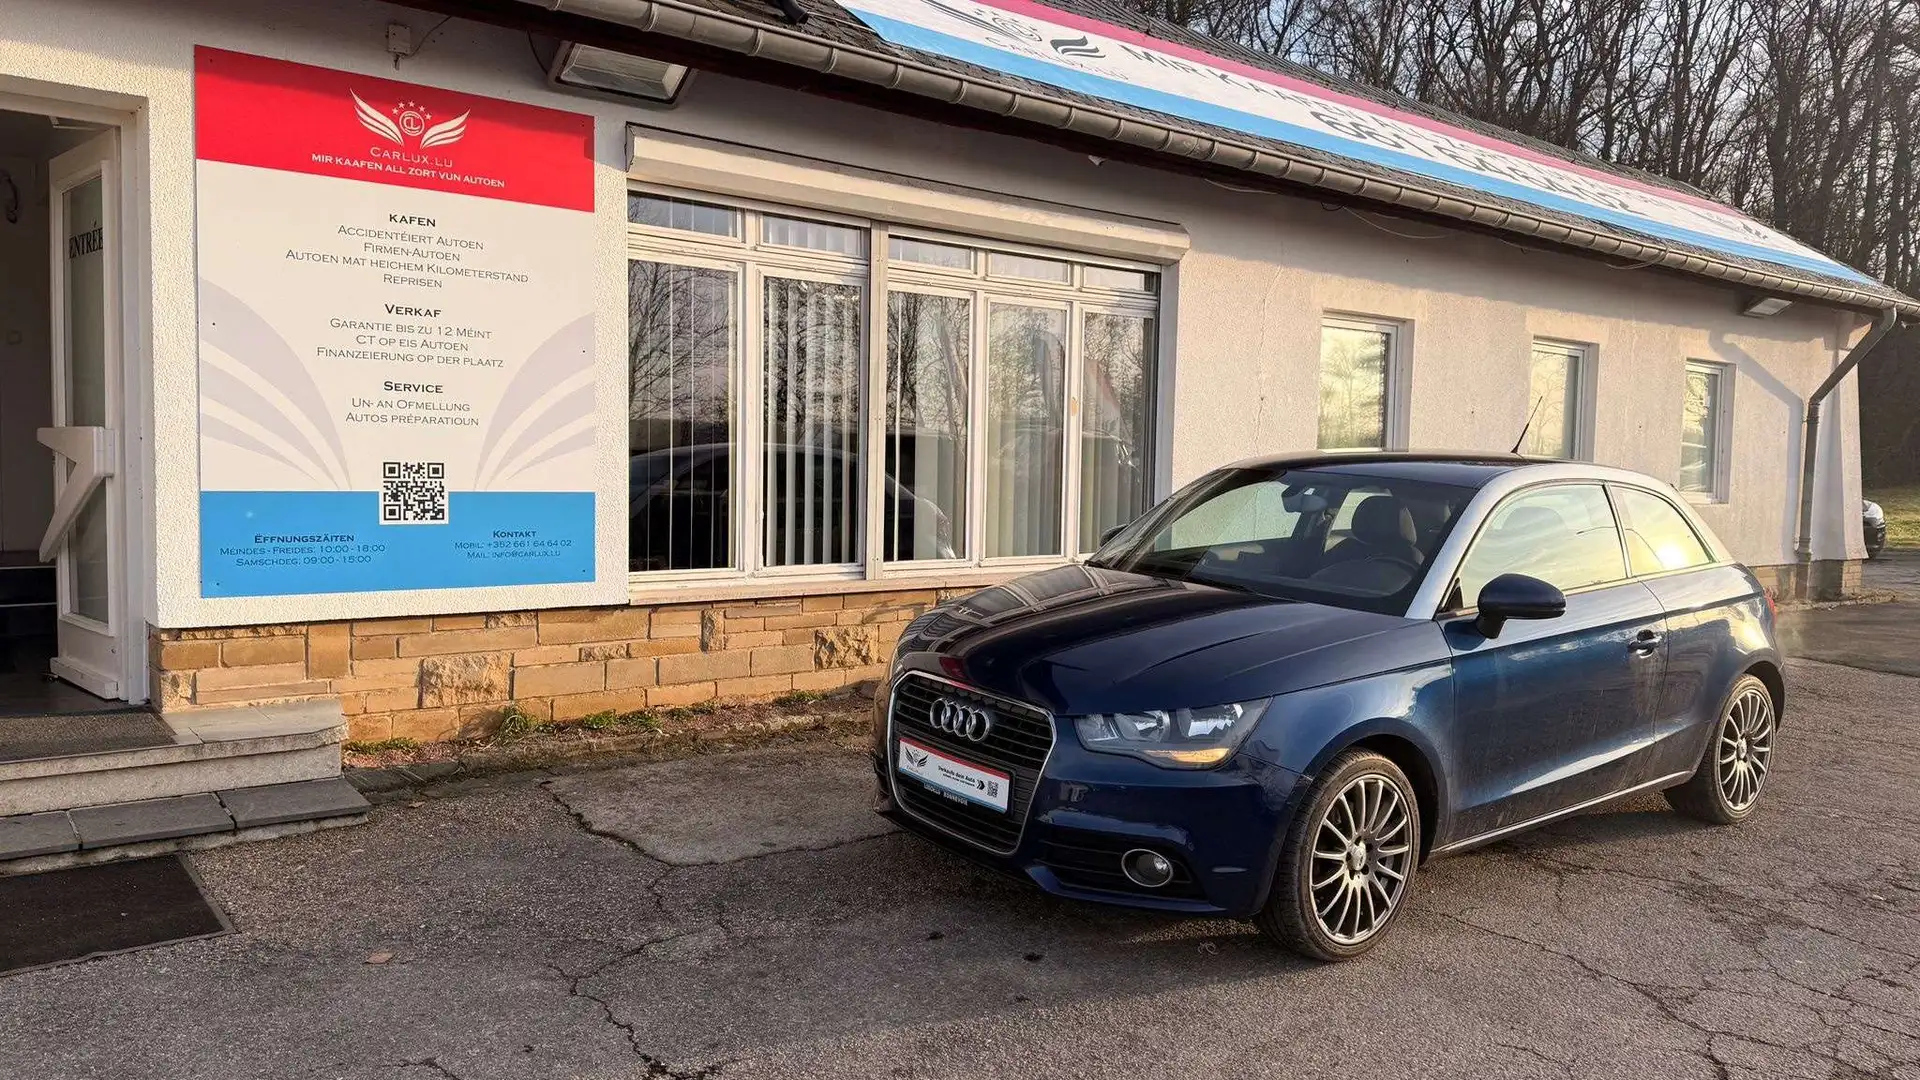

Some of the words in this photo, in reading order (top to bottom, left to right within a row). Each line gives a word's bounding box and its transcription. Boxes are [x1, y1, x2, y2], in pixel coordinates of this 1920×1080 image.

[1118, 44, 1207, 78] MIR
[1310, 111, 1435, 158] 661
[370, 146, 453, 168] CARLUX.LU
[311, 153, 333, 164] MIR
[335, 157, 383, 171] KAAFEN
[385, 164, 406, 175] ALL
[408, 167, 437, 178] ZORT
[438, 171, 461, 182] VUN
[463, 175, 505, 188] AUTOEN
[389, 213, 436, 227] KAFEN
[338, 224, 434, 244] ACCIDENTÉIERT
[436, 236, 484, 250] AUTOEN
[364, 242, 460, 261] FIRMEN-AUTOEN
[286, 249, 339, 264] AUTOEN
[342, 256, 367, 266] MAT
[370, 259, 424, 272] HEICHEM
[427, 263, 529, 283] KILOMETERSTAND
[383, 273, 442, 288] REPRISEN
[384, 303, 442, 318] VERKAF
[330, 318, 393, 332] GARANTIE
[396, 324, 415, 334] BIS
[417, 325, 432, 335] ZU
[437, 326, 453, 336] 12
[456, 327, 492, 339] MÉINT
[356, 334, 376, 345] CT
[378, 337, 397, 346] OP
[399, 338, 418, 348] EIS
[420, 339, 469, 352] AUTOEN
[317, 346, 414, 362] FINANZEIERUNG
[417, 354, 434, 363] OP
[437, 355, 460, 365] DER
[463, 357, 504, 368] PLAATZ
[383, 380, 444, 394] SERVICE
[352, 397, 374, 408] UN-
[376, 400, 393, 409] AN
[396, 399, 471, 412] OFMELLUNG
[345, 412, 388, 423] AUTOS
[391, 413, 479, 426] PRÉPARATIOUN
[254, 534, 355, 544] ËFFNUNGSZÄITEN
[493, 530, 537, 539] KONTAKT
[320, 545, 349, 553] 10:00
[357, 544, 386, 552] 18:00
[513, 540, 530, 548] 661
[560, 539, 572, 547] 02
[303, 556, 334, 565] 09:00
[343, 555, 371, 563] 15:00
